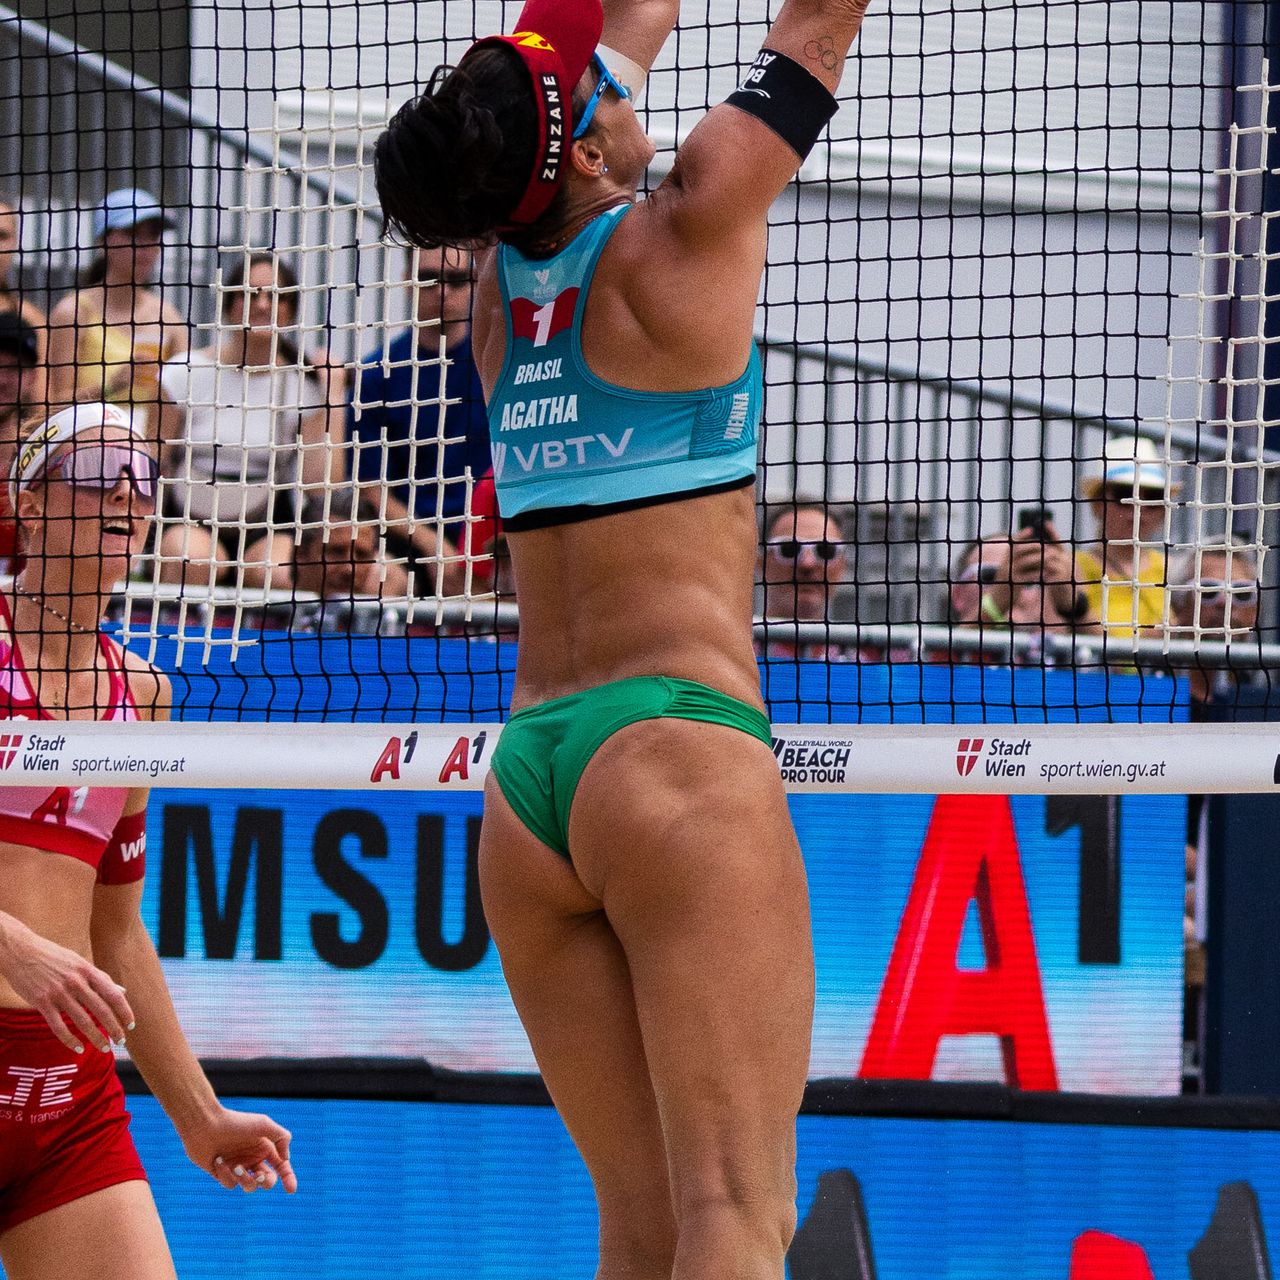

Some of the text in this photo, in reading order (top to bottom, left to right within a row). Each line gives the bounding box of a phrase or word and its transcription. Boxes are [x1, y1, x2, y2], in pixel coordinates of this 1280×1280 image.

[541, 73, 563, 181] ZINZANE
[532, 300, 556, 348] 1
[513, 357, 563, 386] BRASIL
[499, 394, 579, 433] AGATHA
[512, 427, 635, 473] VBTV
[26, 734, 66, 752] Stadt
[787, 740, 828, 748] VOLLEYBALL
[988, 738, 1032, 757] Stadt
[22, 753, 60, 772] Wien
[71, 755, 186, 778] sport.wien.gv.at
[370, 730, 419, 783] A1
[438, 730, 487, 784] A1
[781, 748, 851, 768] BEACH
[985, 758, 1026, 777] Wien
[780, 768, 846, 784] PRO TOUR
[1039, 759, 1167, 783] sport.wien.gv.at
[857, 793, 1122, 1092] A1
